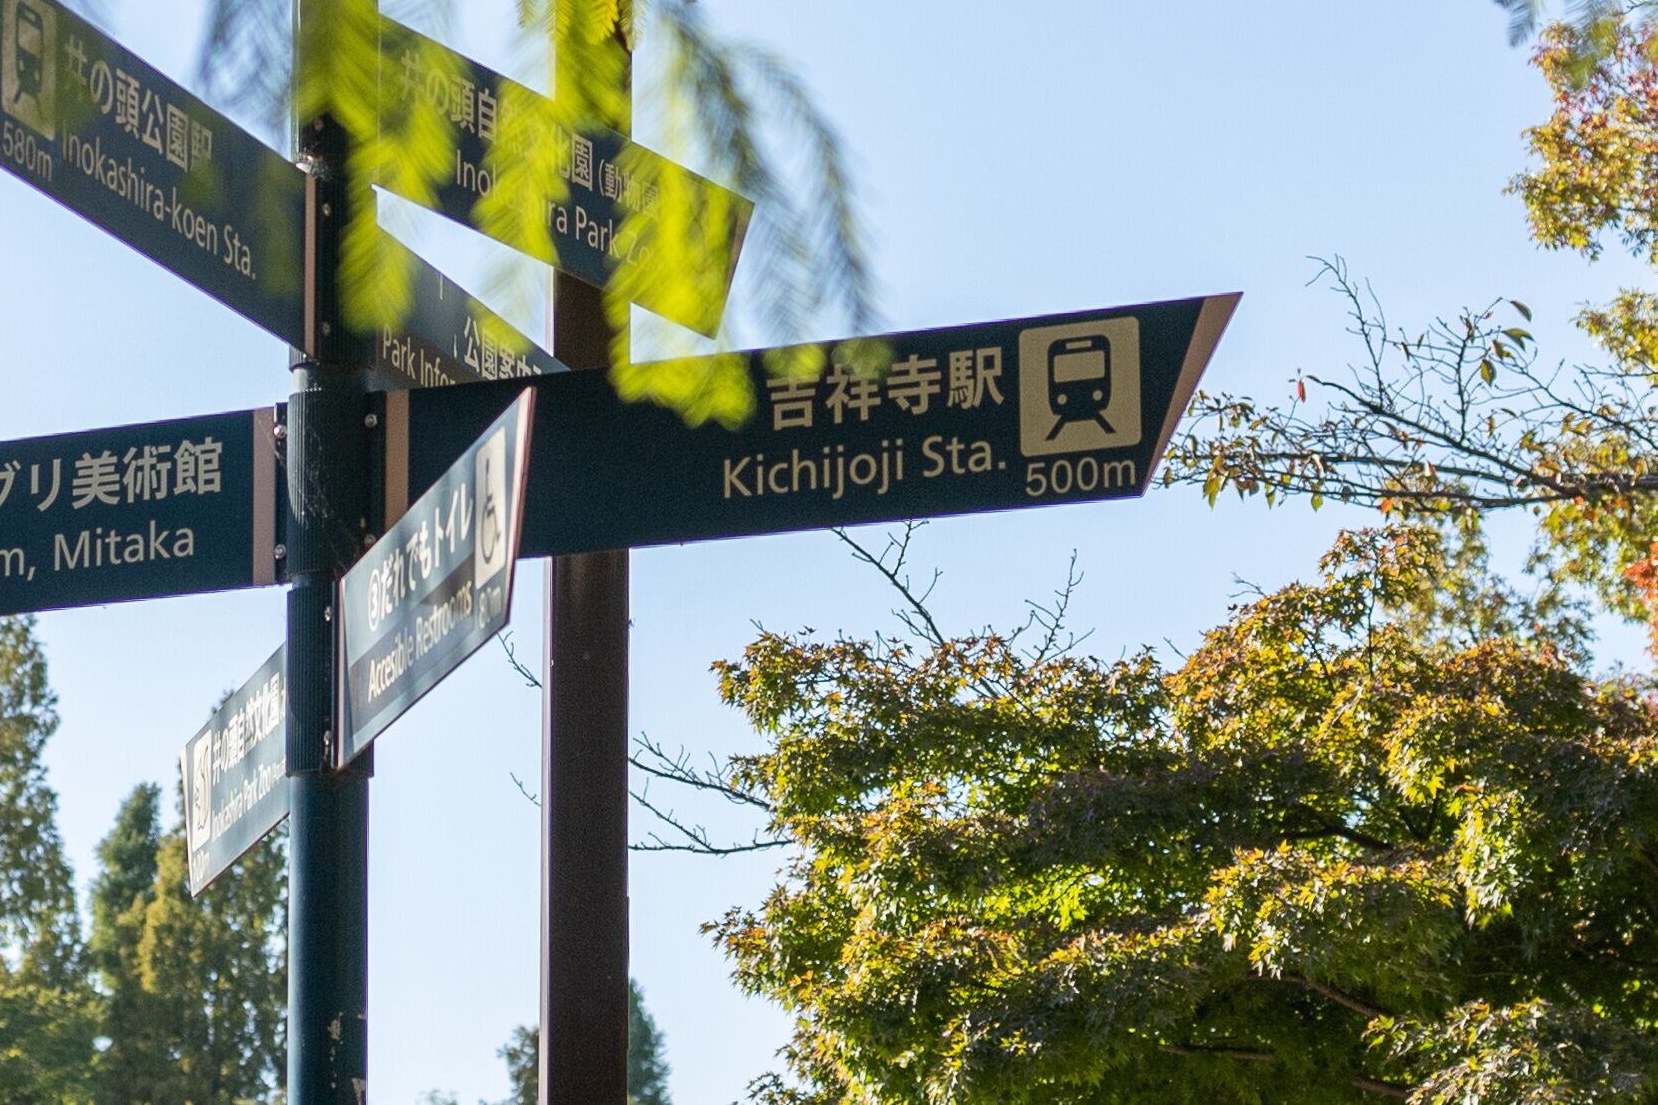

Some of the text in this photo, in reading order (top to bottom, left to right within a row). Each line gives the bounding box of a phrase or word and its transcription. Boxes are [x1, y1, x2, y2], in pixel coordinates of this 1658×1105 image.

[3, 120, 53, 182] 580m
[63, 120, 257, 280] Inokashira-koen Sta.
[456, 149, 568, 235] Inokira
[575, 205, 619, 257] Park
[383, 324, 416, 380] Park
[766, 345, 1005, 431] 吉祥寺駅
[723, 435, 1007, 500] Kichijoji Sta.
[1025, 457, 1136, 497] 500m
[53, 520, 196, 572] Mitaka
[415, 579, 473, 660] Restrooms
